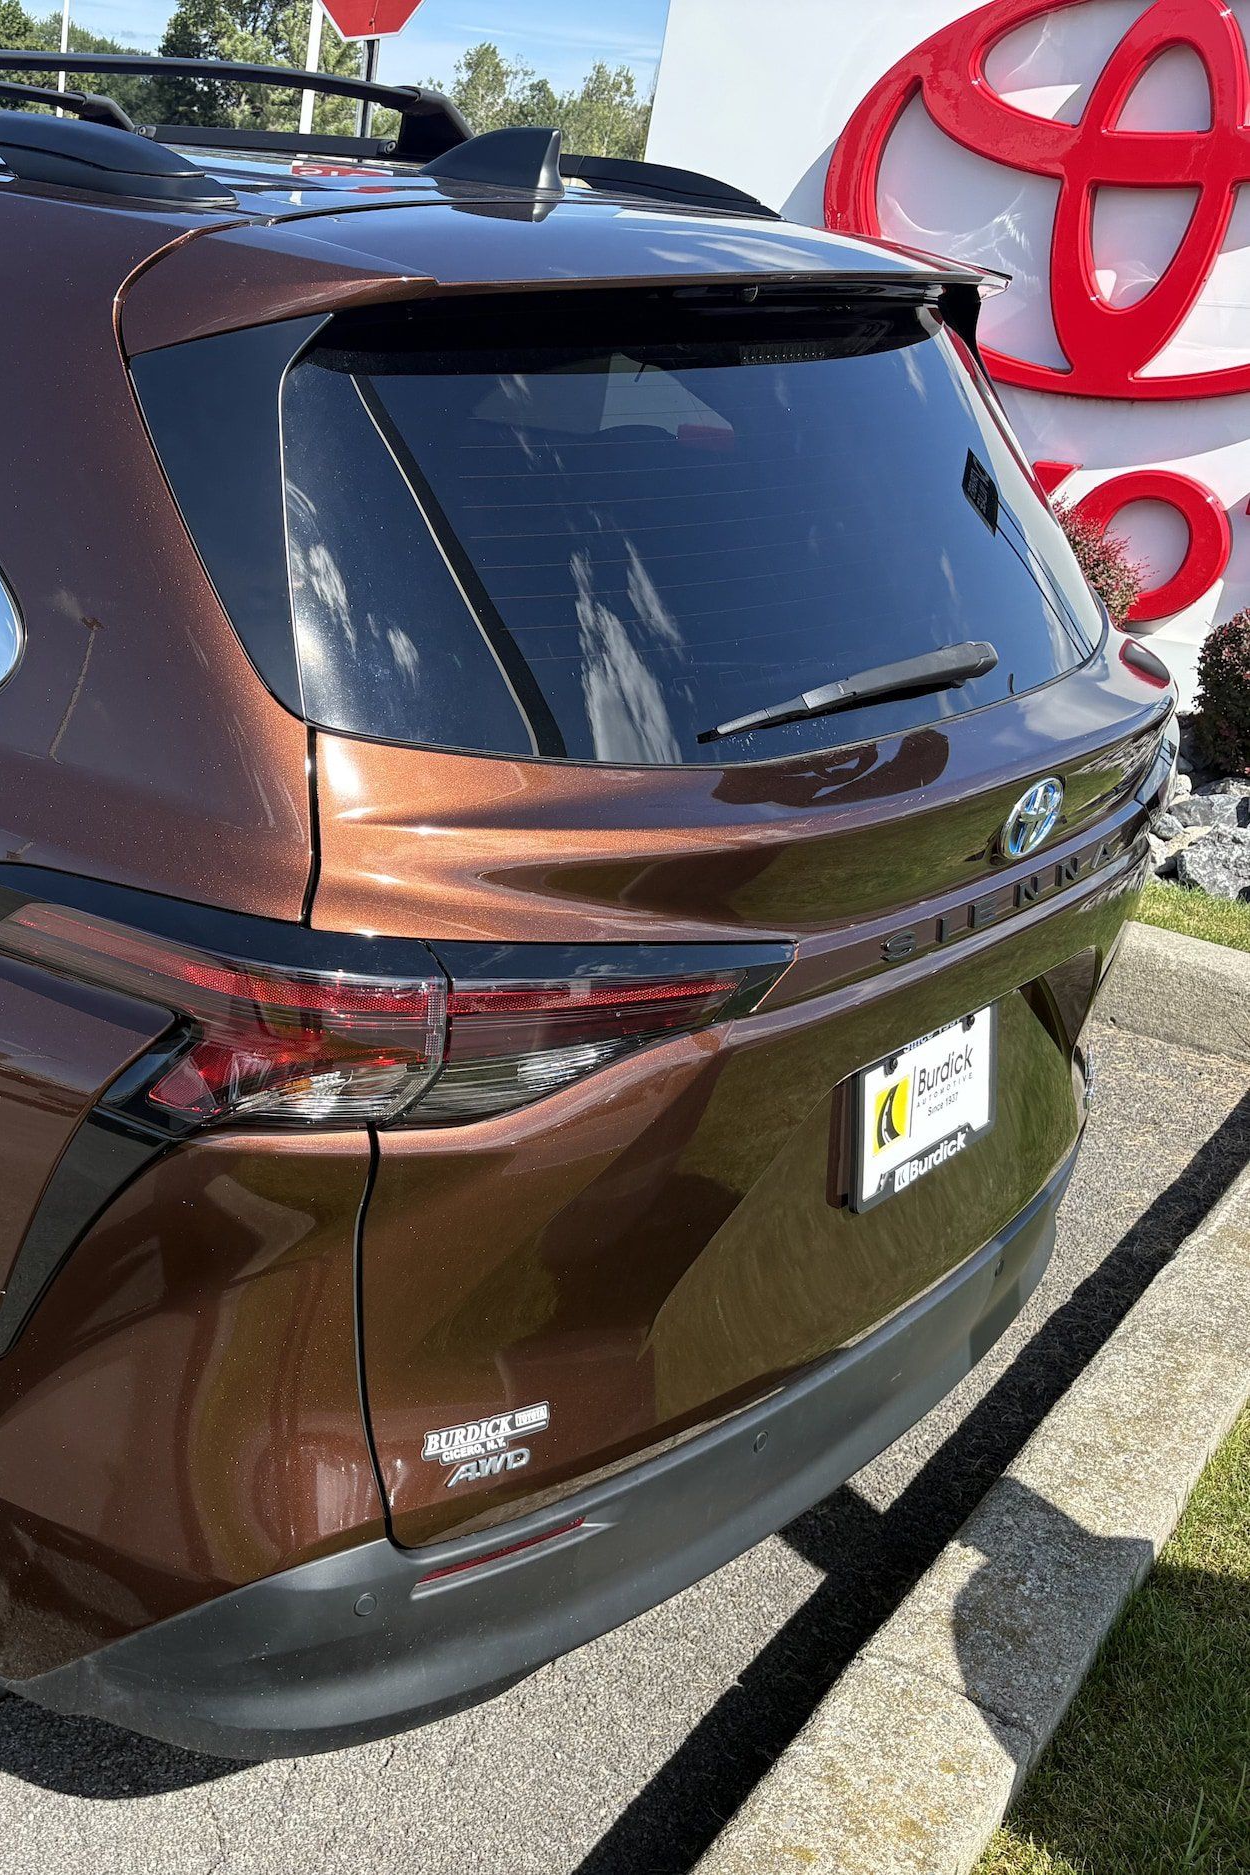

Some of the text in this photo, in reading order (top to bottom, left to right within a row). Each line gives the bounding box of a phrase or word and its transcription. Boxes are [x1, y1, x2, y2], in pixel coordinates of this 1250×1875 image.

[880, 841, 1115, 962] SIENNA
[918, 1044, 973, 1097] Burdick
[917, 1072, 973, 1109] AUTOMOTIVE
[928, 1102, 944, 1117] Since
[909, 1131, 967, 1182] Burdick
[426, 1415, 513, 1452] BURDICK
[442, 1436, 507, 1462] CICERO, N.Y.
[446, 1448, 531, 1488] AWD
